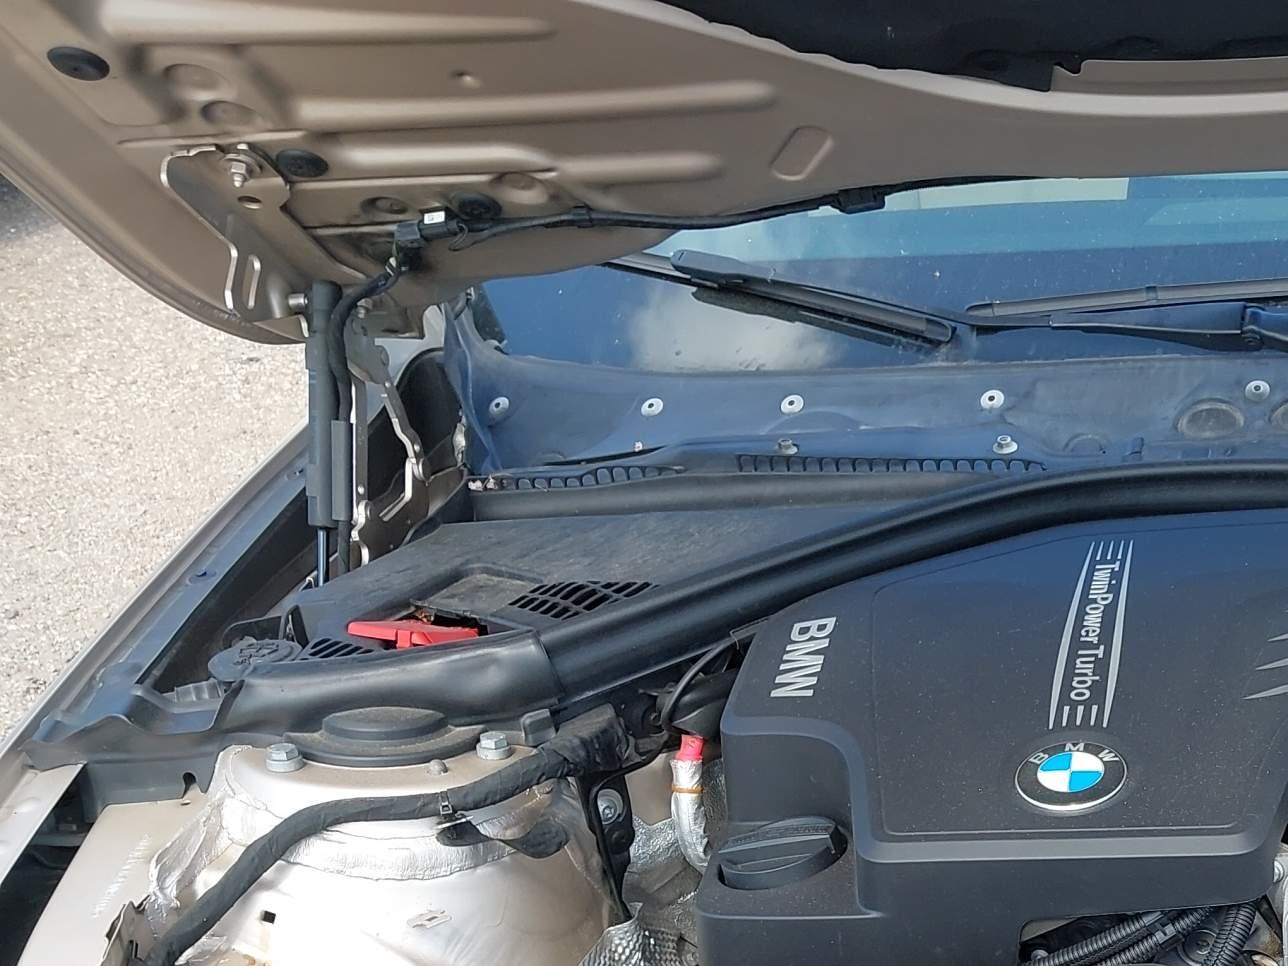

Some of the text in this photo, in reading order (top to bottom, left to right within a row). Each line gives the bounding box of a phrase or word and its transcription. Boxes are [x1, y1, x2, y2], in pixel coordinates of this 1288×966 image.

[770, 617, 836, 697] BMW
[1070, 560, 1121, 701] TwinPower Turbo
[1028, 742, 1120, 765] BMW
